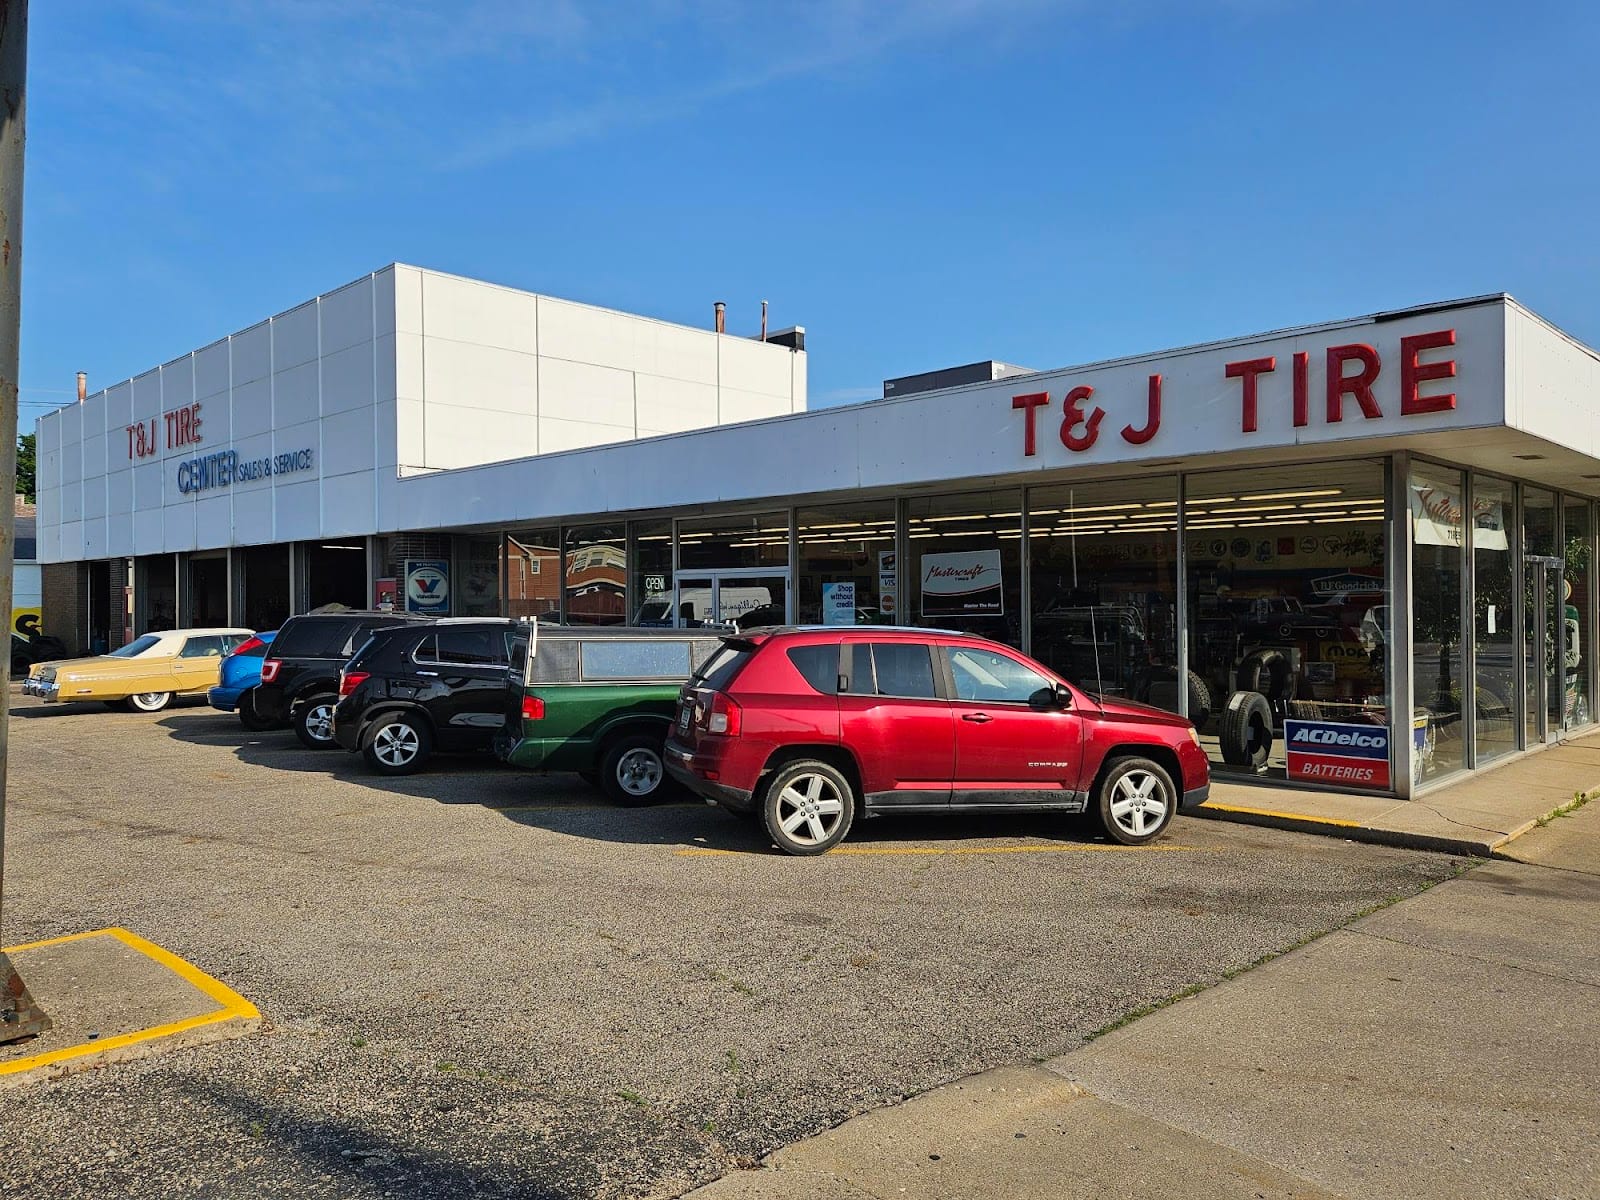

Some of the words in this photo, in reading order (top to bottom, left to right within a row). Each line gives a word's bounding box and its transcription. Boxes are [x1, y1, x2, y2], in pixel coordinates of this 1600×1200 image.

[1012, 373, 1162, 457] T&J
[1225, 328, 1458, 433] TIRE
[126, 419, 157, 460] T&J
[164, 403, 203, 449] TIRE
[177, 450, 239, 494] CENTER
[239, 460, 263, 482] SALES
[264, 458, 273, 477] &
[273, 448, 313, 475] SERVICE
[645, 577, 664, 590] OPEN
[925, 564, 985, 583] Mastercraft
[837, 584, 854, 593] Shop
[1292, 728, 1387, 749] ACDelco
[1302, 762, 1374, 781] BATTERIES
